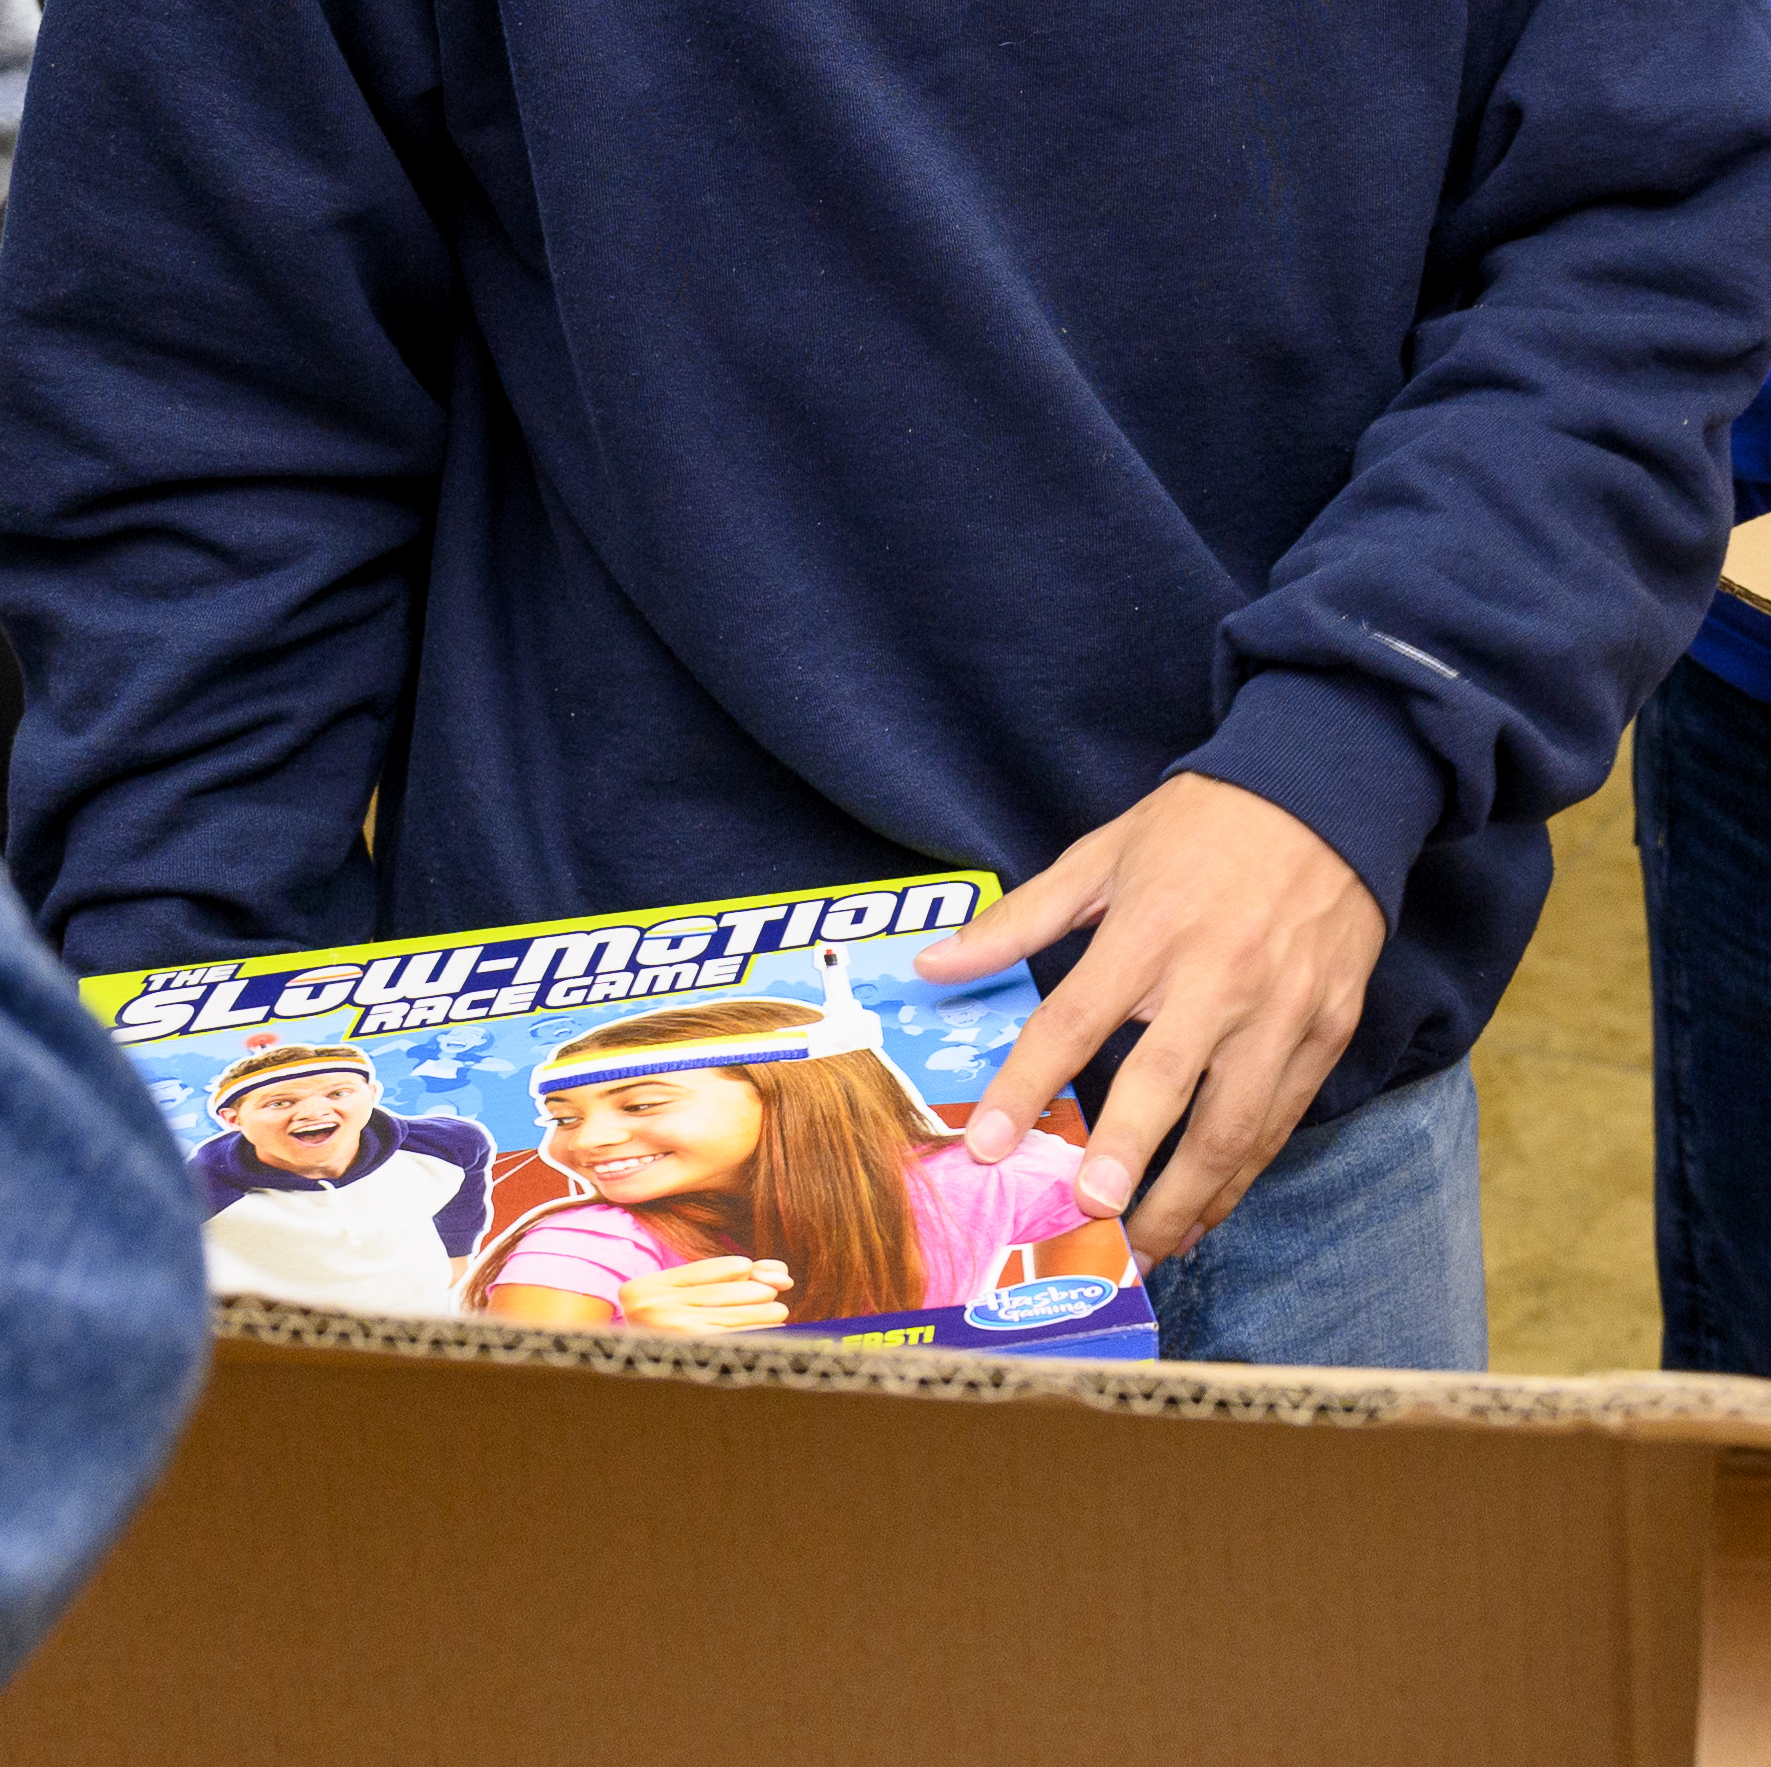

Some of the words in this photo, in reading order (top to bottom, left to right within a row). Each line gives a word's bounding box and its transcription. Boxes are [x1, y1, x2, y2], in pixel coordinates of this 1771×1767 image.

[111, 881, 975, 1043] SLOW-MOTION
[147, 963, 239, 990] THE
[358, 982, 535, 1034] RACE
[545, 955, 742, 1009] GAME
[972, 1286, 1105, 1311] Hasbro
[997, 1300, 1087, 1322] Gaming
[842, 1324, 936, 1353] FAST!
